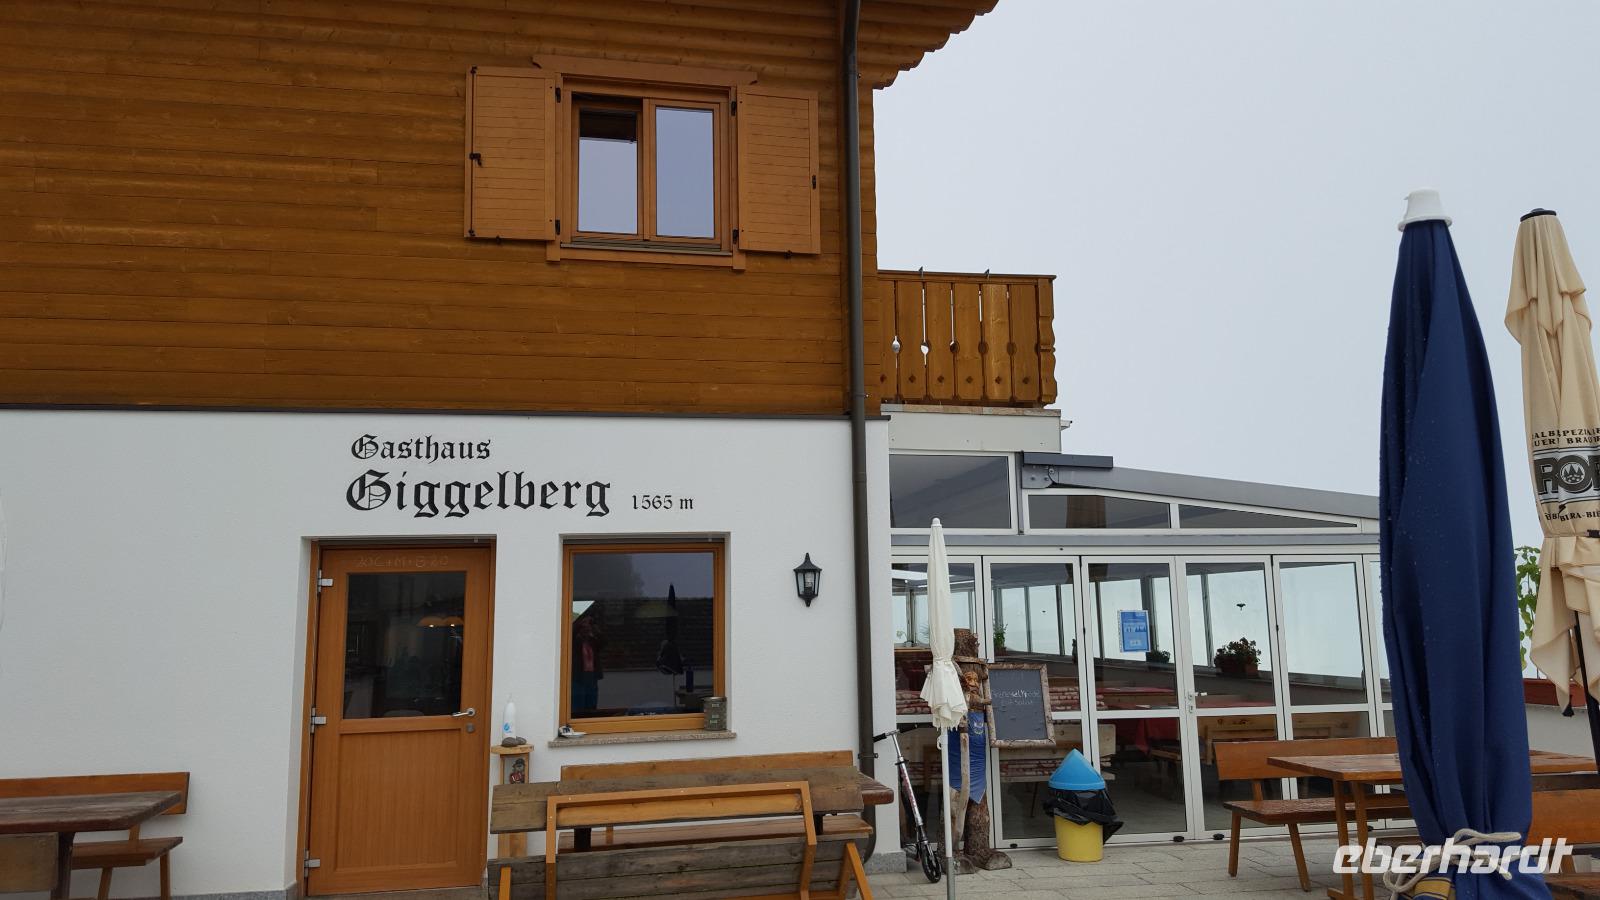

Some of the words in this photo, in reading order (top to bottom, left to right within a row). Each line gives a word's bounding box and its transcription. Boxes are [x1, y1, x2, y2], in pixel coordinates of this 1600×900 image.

[351, 434, 490, 462] Gasthaus
[346, 469, 610, 518] Giggelberg
[632, 495, 672, 509] 1565
[680, 499, 693, 509] m
